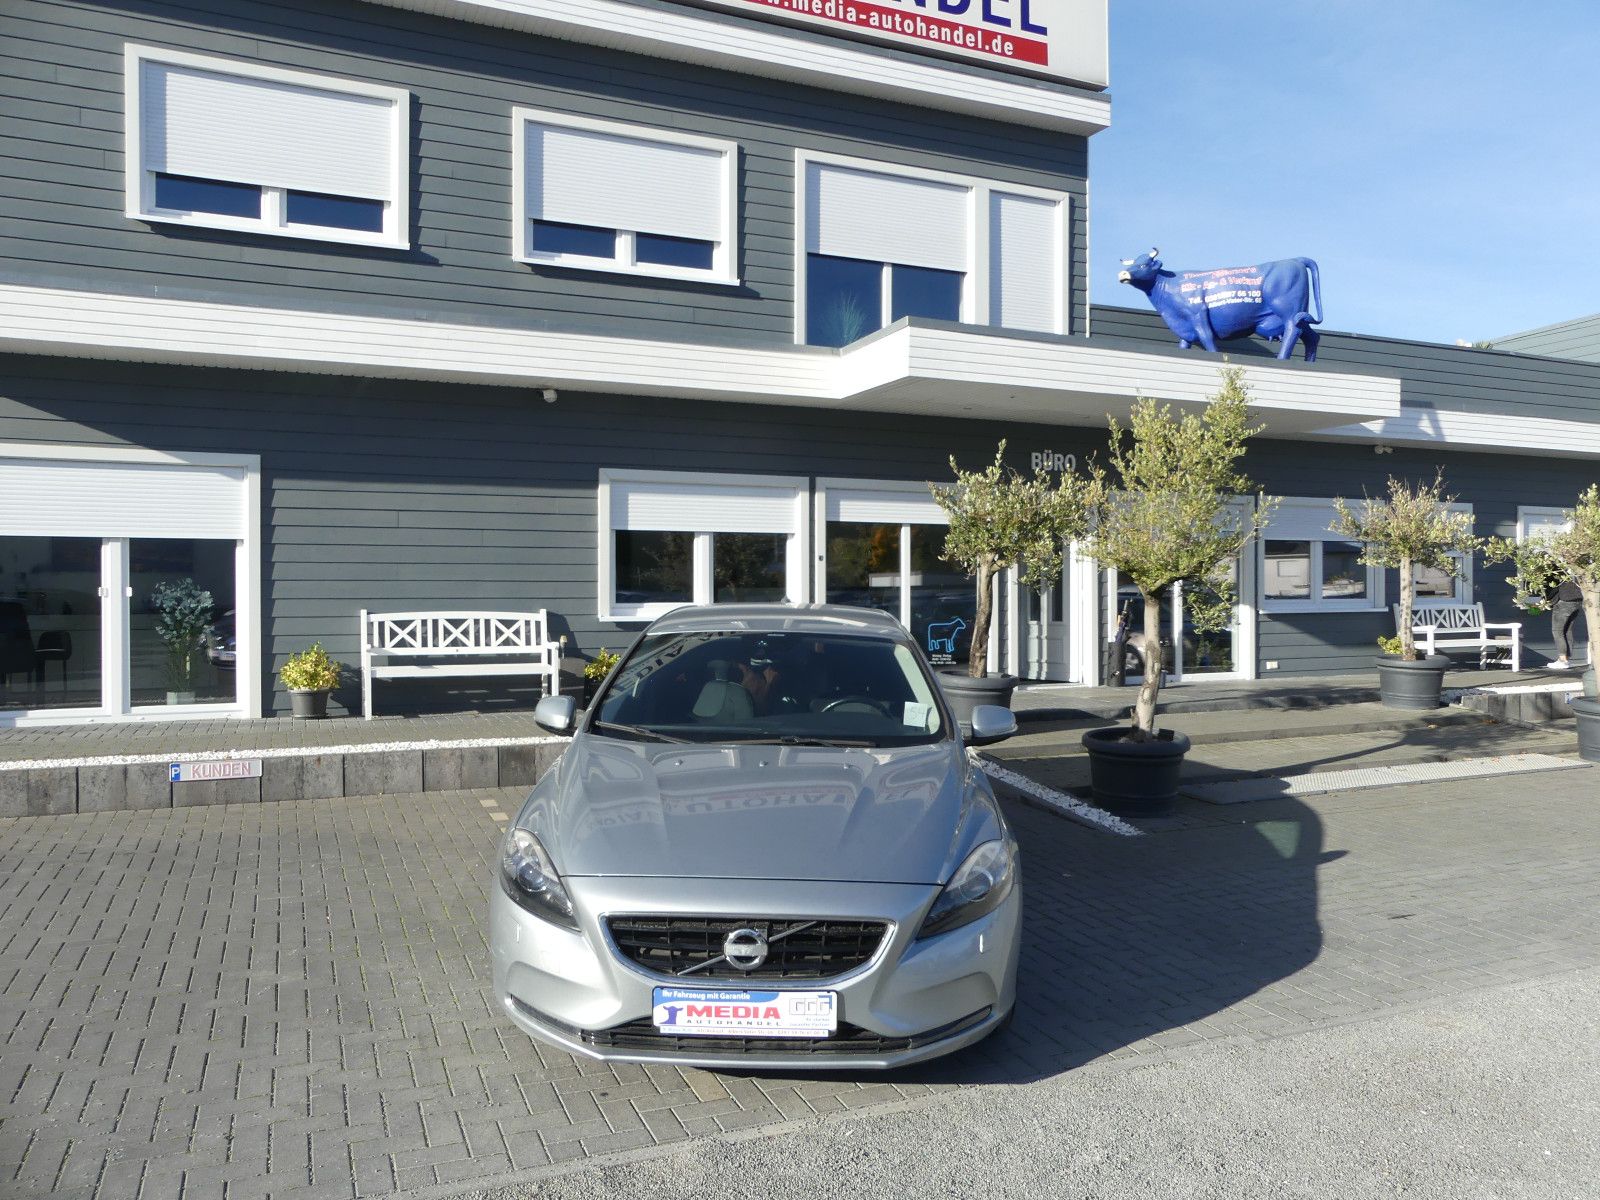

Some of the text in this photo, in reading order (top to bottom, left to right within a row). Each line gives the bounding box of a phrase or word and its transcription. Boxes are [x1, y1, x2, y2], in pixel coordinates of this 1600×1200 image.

[1031, 449, 1076, 472] BÜRO
[191, 762, 251, 779] KUNDEN
[662, 989, 672, 998] Ihr
[673, 990, 706, 1000] Fahrzeug
[706, 991, 719, 999] mit
[686, 1004, 781, 1019] MEDIA
